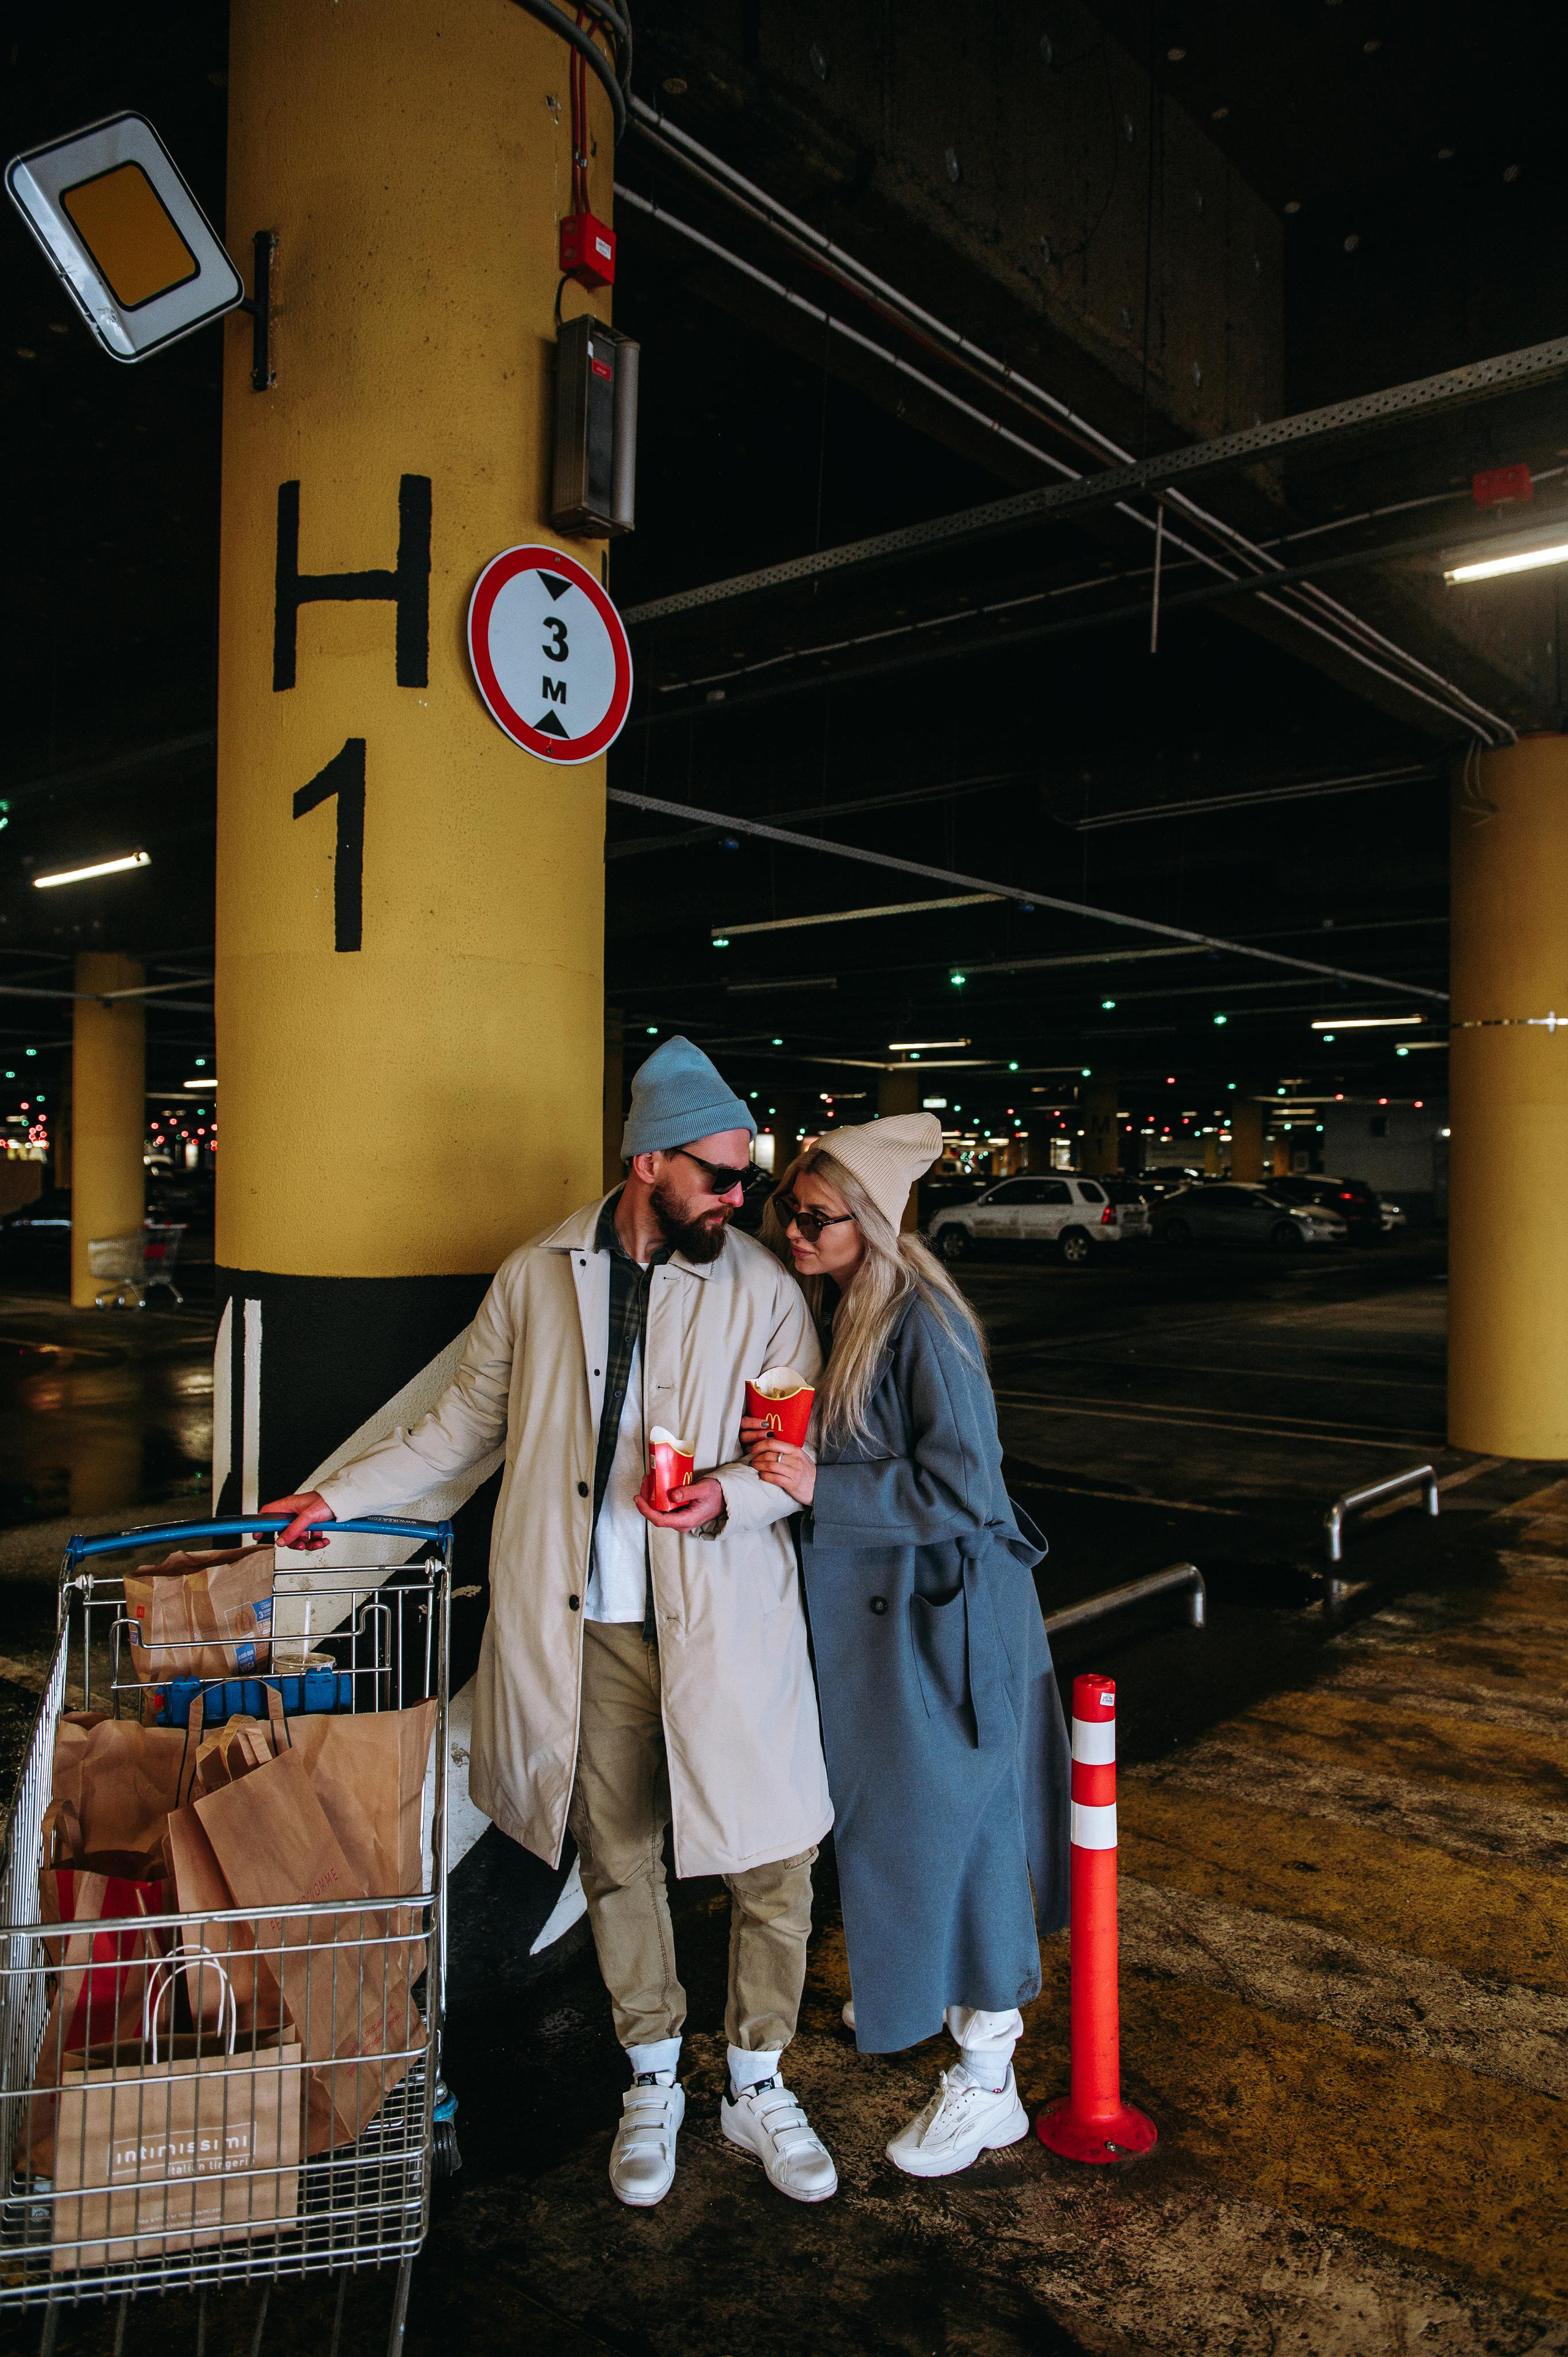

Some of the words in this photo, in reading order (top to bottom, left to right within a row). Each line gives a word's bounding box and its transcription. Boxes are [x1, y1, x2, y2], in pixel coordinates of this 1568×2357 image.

[273, 473, 432, 692] H
[542, 616, 569, 662] 3
[293, 737, 366, 953] 1
[116, 2135, 247, 2164] intimissimi
